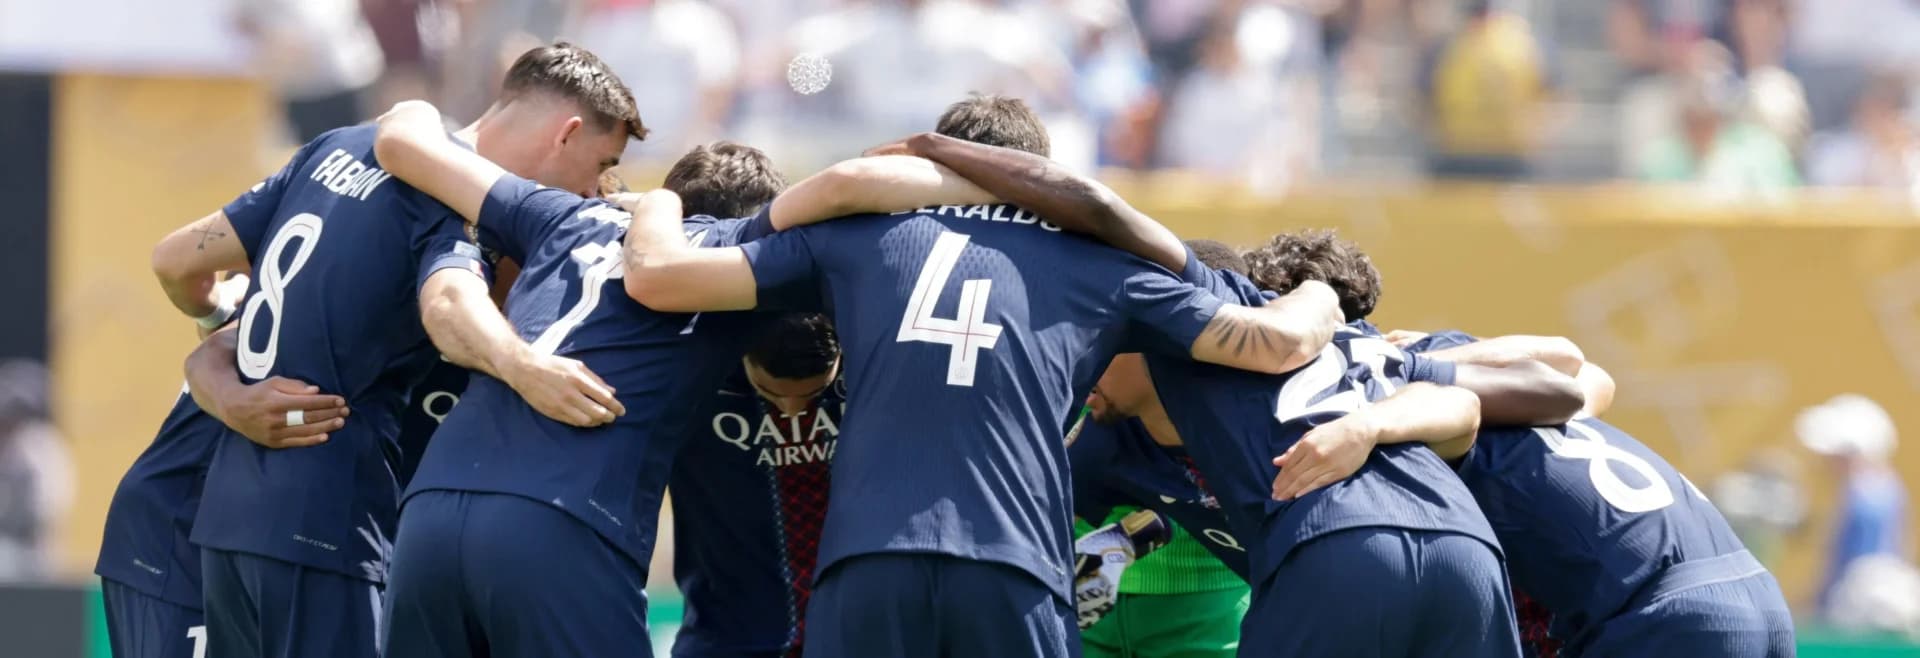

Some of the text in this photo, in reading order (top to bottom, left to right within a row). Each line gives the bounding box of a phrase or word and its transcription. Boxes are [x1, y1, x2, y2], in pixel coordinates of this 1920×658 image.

[237, 212, 323, 379] 8
[896, 231, 1003, 387] 4
[712, 402, 847, 451] QATA
